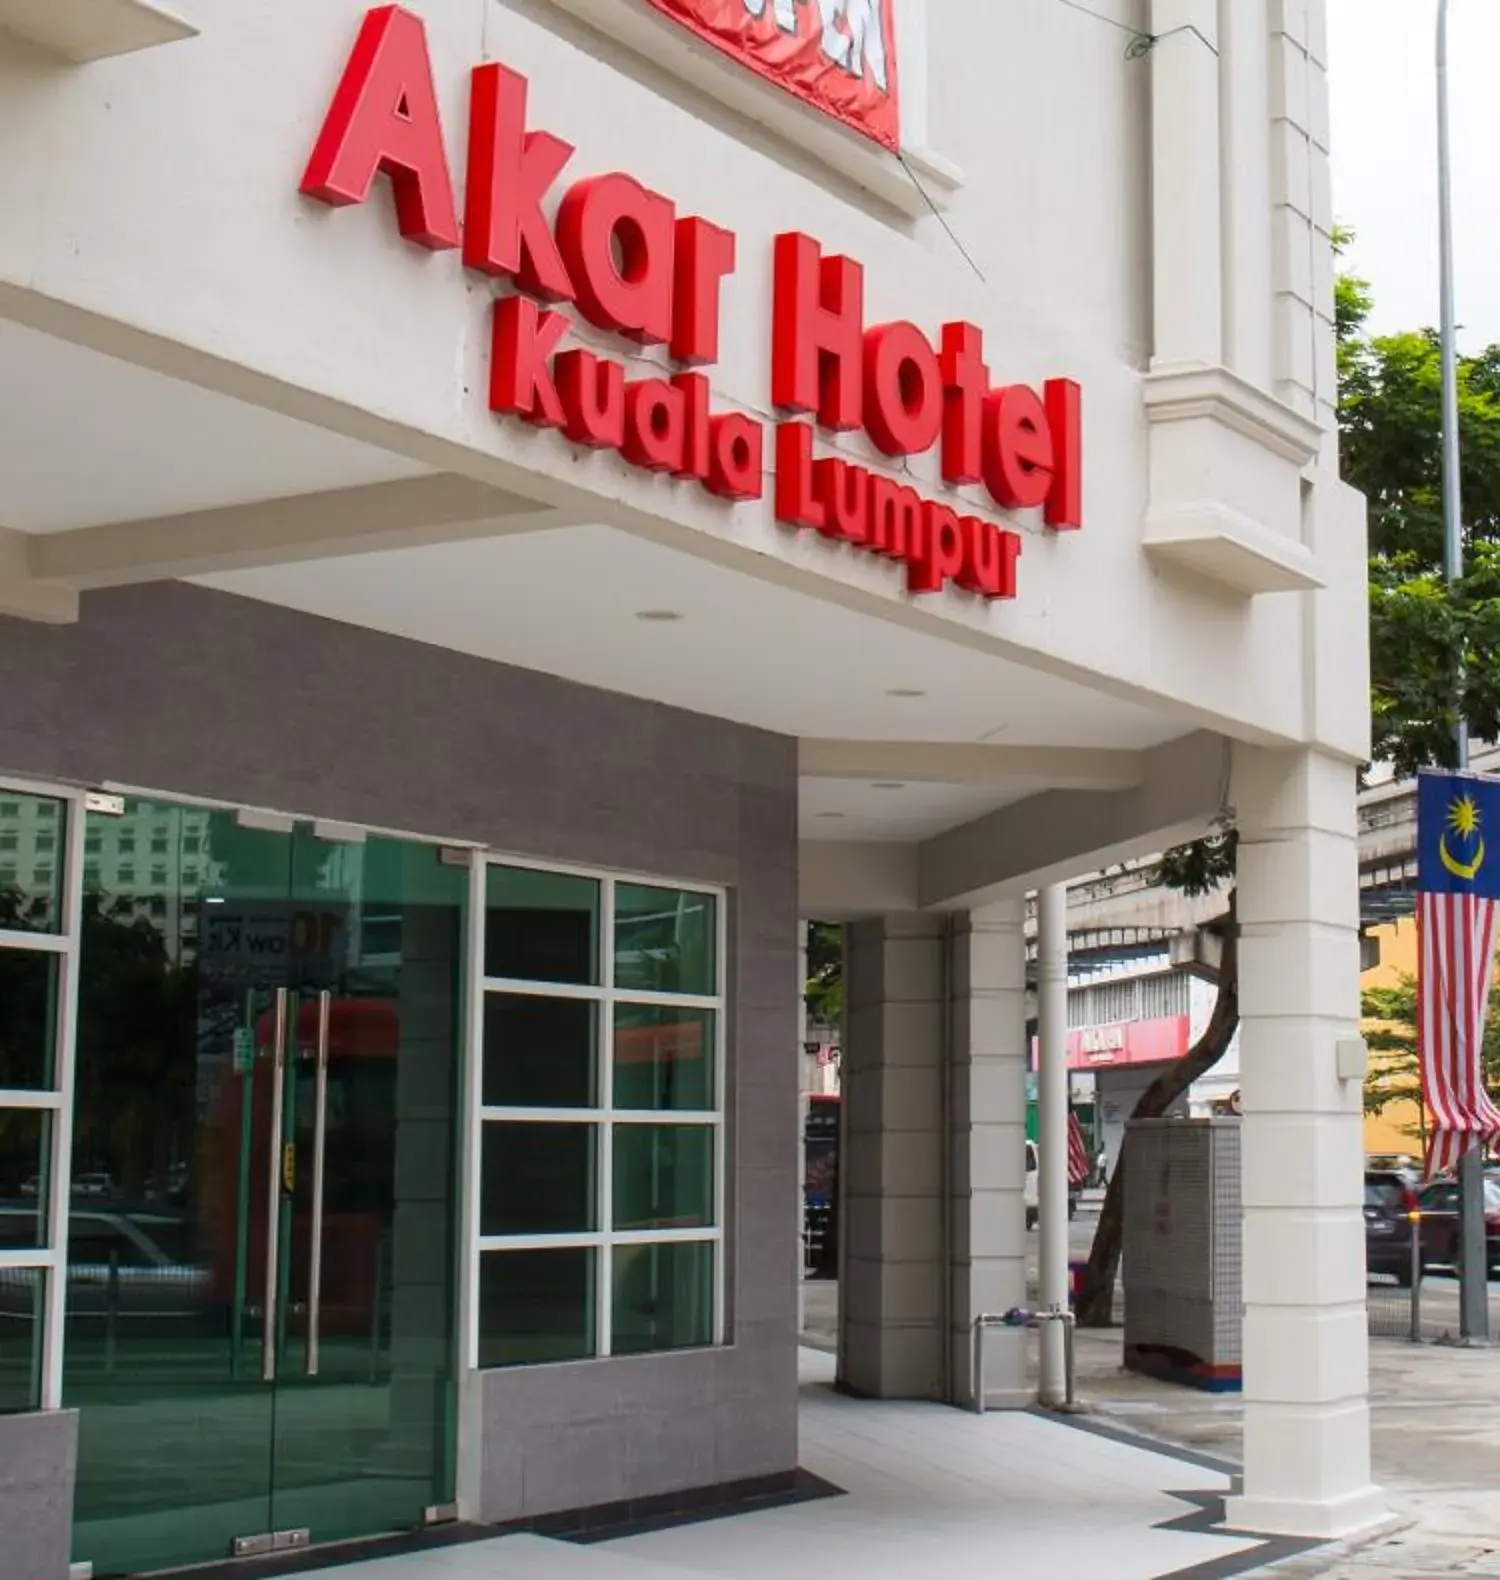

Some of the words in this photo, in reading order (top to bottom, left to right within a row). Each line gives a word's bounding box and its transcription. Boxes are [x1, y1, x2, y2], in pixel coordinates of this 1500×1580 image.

[299, 3, 735, 366] Akar
[771, 231, 1082, 532] Hotel
[490, 296, 763, 503] Kuala
[775, 419, 1022, 600] Lumpur
